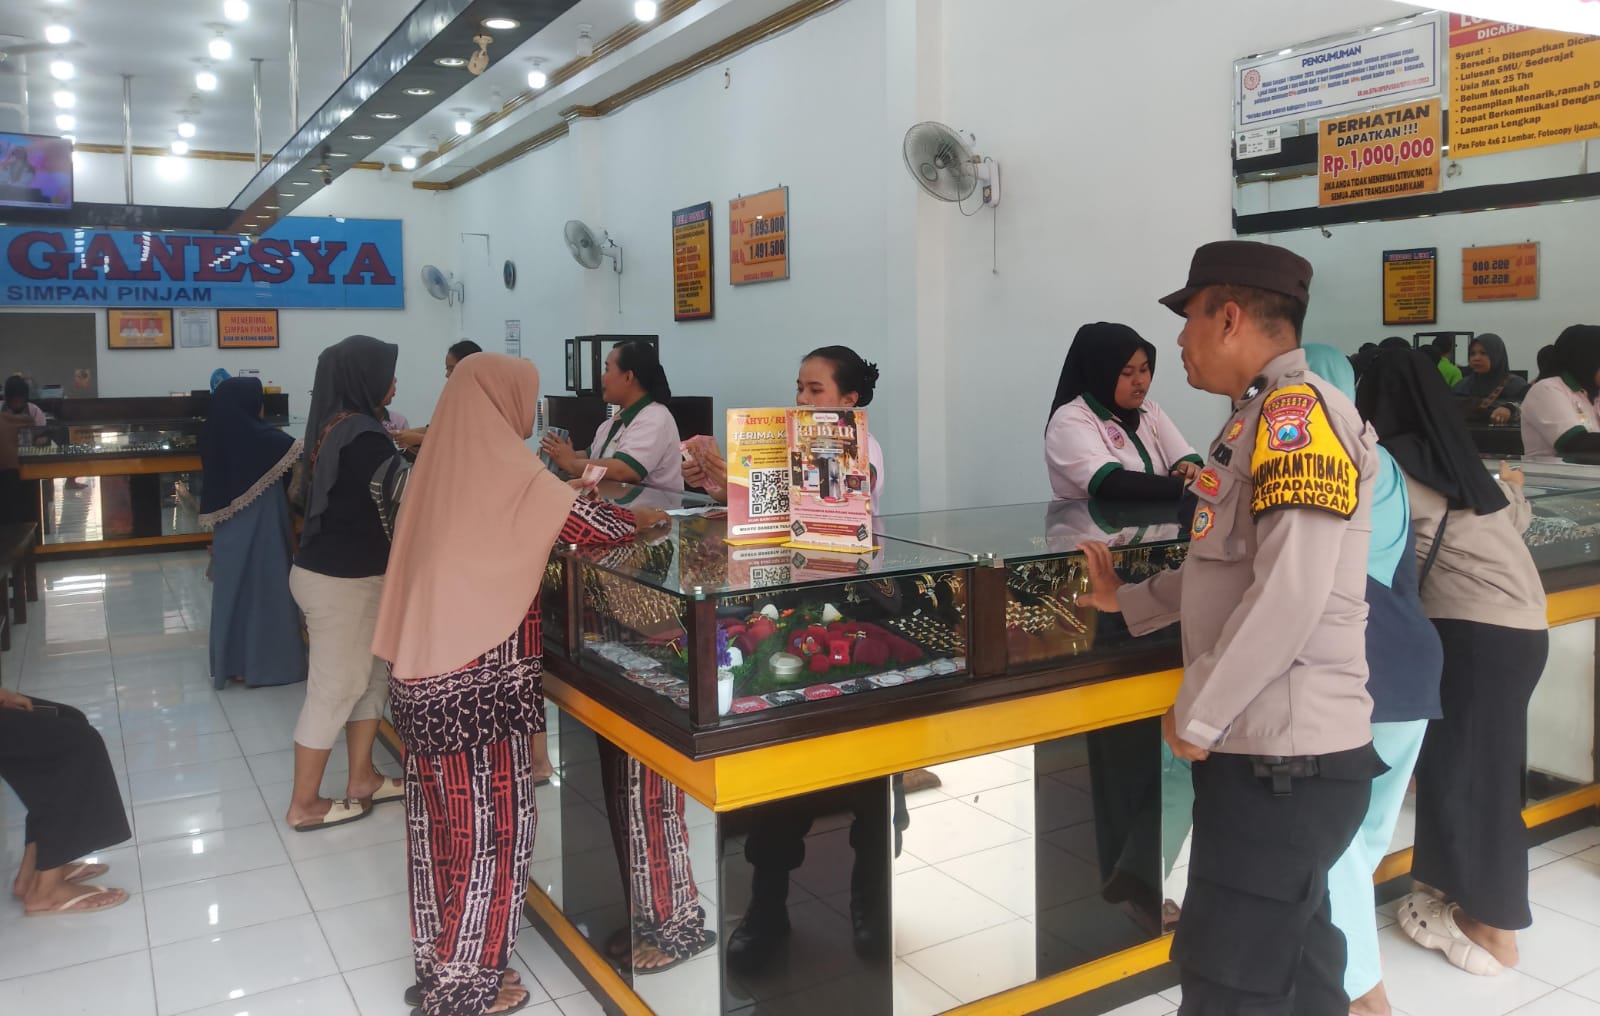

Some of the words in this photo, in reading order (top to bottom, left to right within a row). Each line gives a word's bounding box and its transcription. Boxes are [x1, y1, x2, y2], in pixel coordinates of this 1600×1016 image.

[1477, 22, 1520, 40] DICARI
[1302, 45, 1362, 68] PENGUMUMAN
[1455, 47, 1484, 60] Syarat
[1460, 55, 1500, 70] Bersedia
[1502, 42, 1565, 61] Ditempatkan
[1460, 68, 1495, 81] Lulusan
[1525, 50, 1574, 68] Sederajat
[1460, 81, 1480, 92] Usia
[1481, 78, 1501, 88] Max
[1502, 74, 1515, 84] 25
[1517, 71, 1534, 81] Thn
[1460, 91, 1488, 103] Belum
[1489, 82, 1530, 97] Menikah
[1460, 98, 1513, 114] Penampilan
[1460, 112, 1487, 126] Dapat
[1488, 99, 1559, 120] Berkomunikasi
[1561, 92, 1600, 107] Dengan
[1327, 104, 1430, 136] PERHATIAN
[1460, 121, 1499, 136] Lamaran
[1501, 114, 1541, 129] Lengkap
[1337, 126, 1401, 147] DAPATKAN
[1471, 139, 1486, 149] Foto
[1487, 136, 1500, 146] 4x6
[1537, 126, 1573, 139] Fotocopy
[1322, 154, 1349, 179] Rp.
[1350, 136, 1435, 172] 1,000,000
[1323, 181, 1336, 191] JIKA
[1335, 179, 1351, 190] ANDA
[1351, 177, 1368, 188] TIDAK
[1367, 172, 1397, 185] MENERIMA
[1331, 189, 1349, 201] SEMUA
[1348, 187, 1364, 199] JENIS
[1364, 184, 1395, 197] TRANSAKSI
[1394, 182, 1409, 194] DARI
[1408, 180, 1425, 193] KAMI
[6, 231, 396, 285] GANESYA
[7, 286, 108, 301] SIMPAN
[117, 286, 212, 302] PINJAM
[736, 416, 769, 425] WAHYU
[733, 431, 775, 441] TERIMA
[1260, 479, 1350, 501] KEPADANGAN
[1260, 492, 1350, 514] TULANGAN
